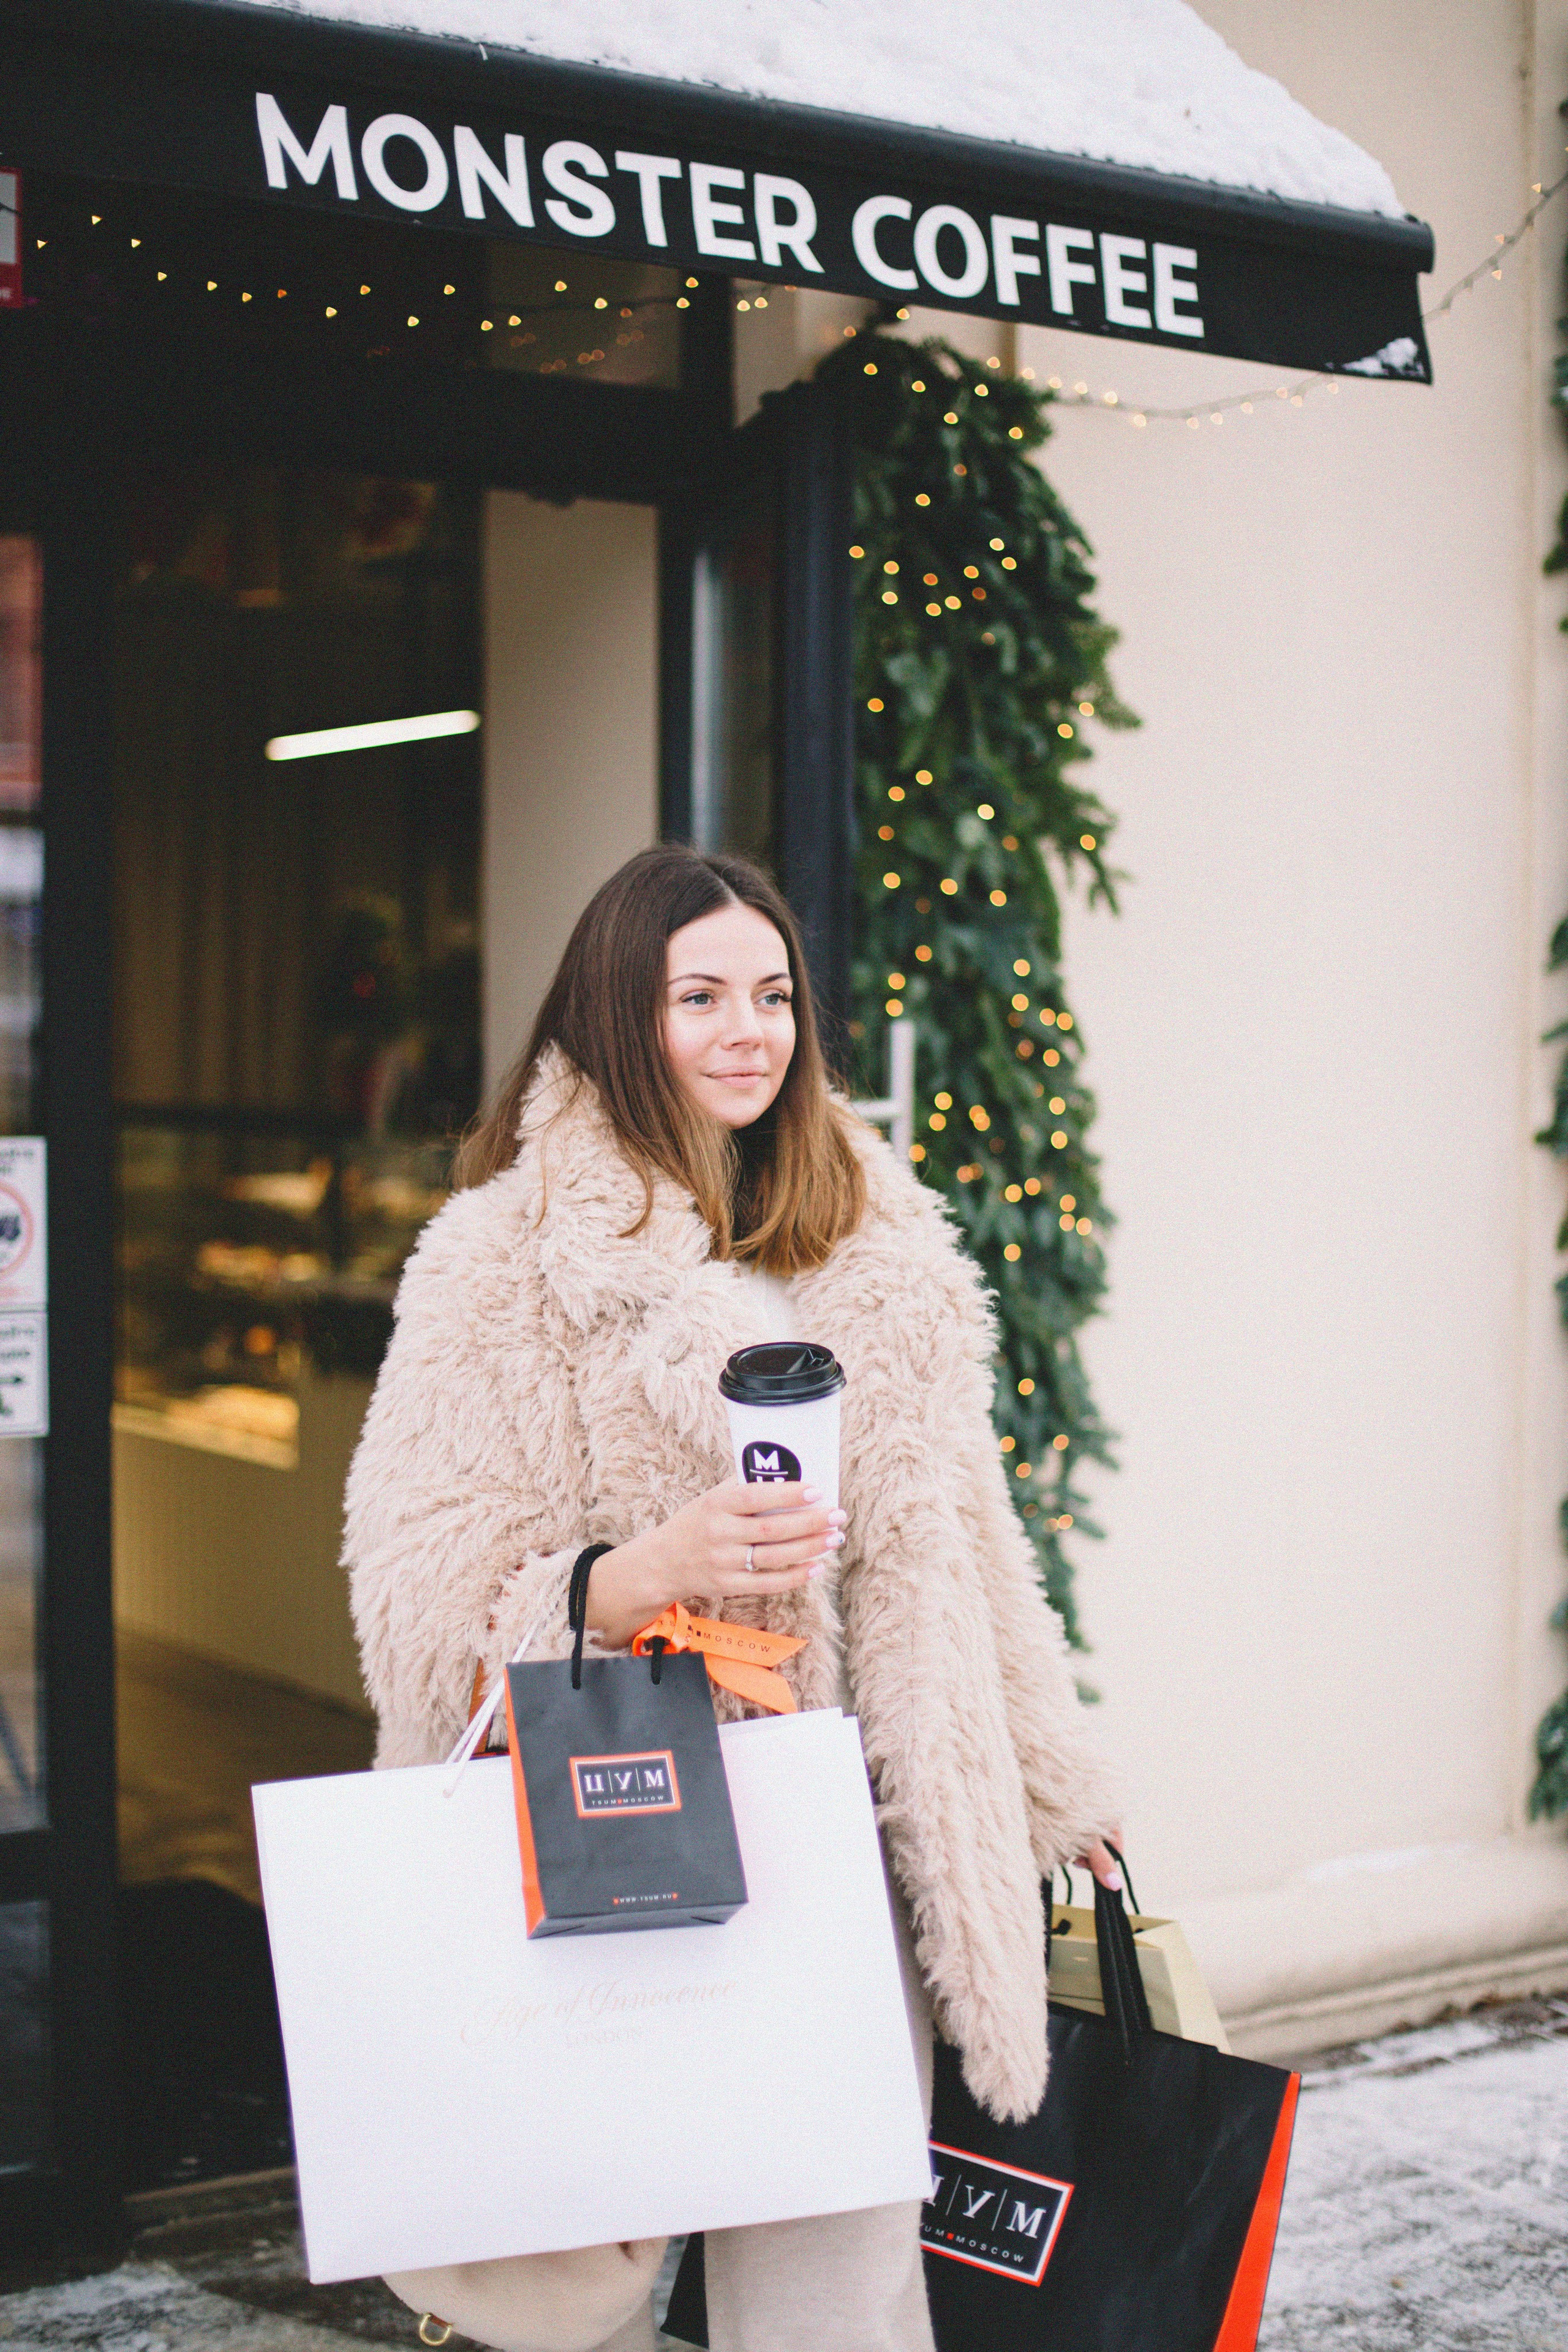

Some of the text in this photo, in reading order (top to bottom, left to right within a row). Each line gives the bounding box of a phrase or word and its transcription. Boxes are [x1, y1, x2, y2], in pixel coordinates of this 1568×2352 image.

[256, 92, 1205, 338] MONSTER COFFEE
[753, 1449, 780, 1470] M
[703, 1632, 771, 1653] MOSCOW
[624, 1795, 664, 1804] MOSCOW
[554, 1986, 586, 2024] of
[956, 2235, 1024, 2263] MOSCOW
